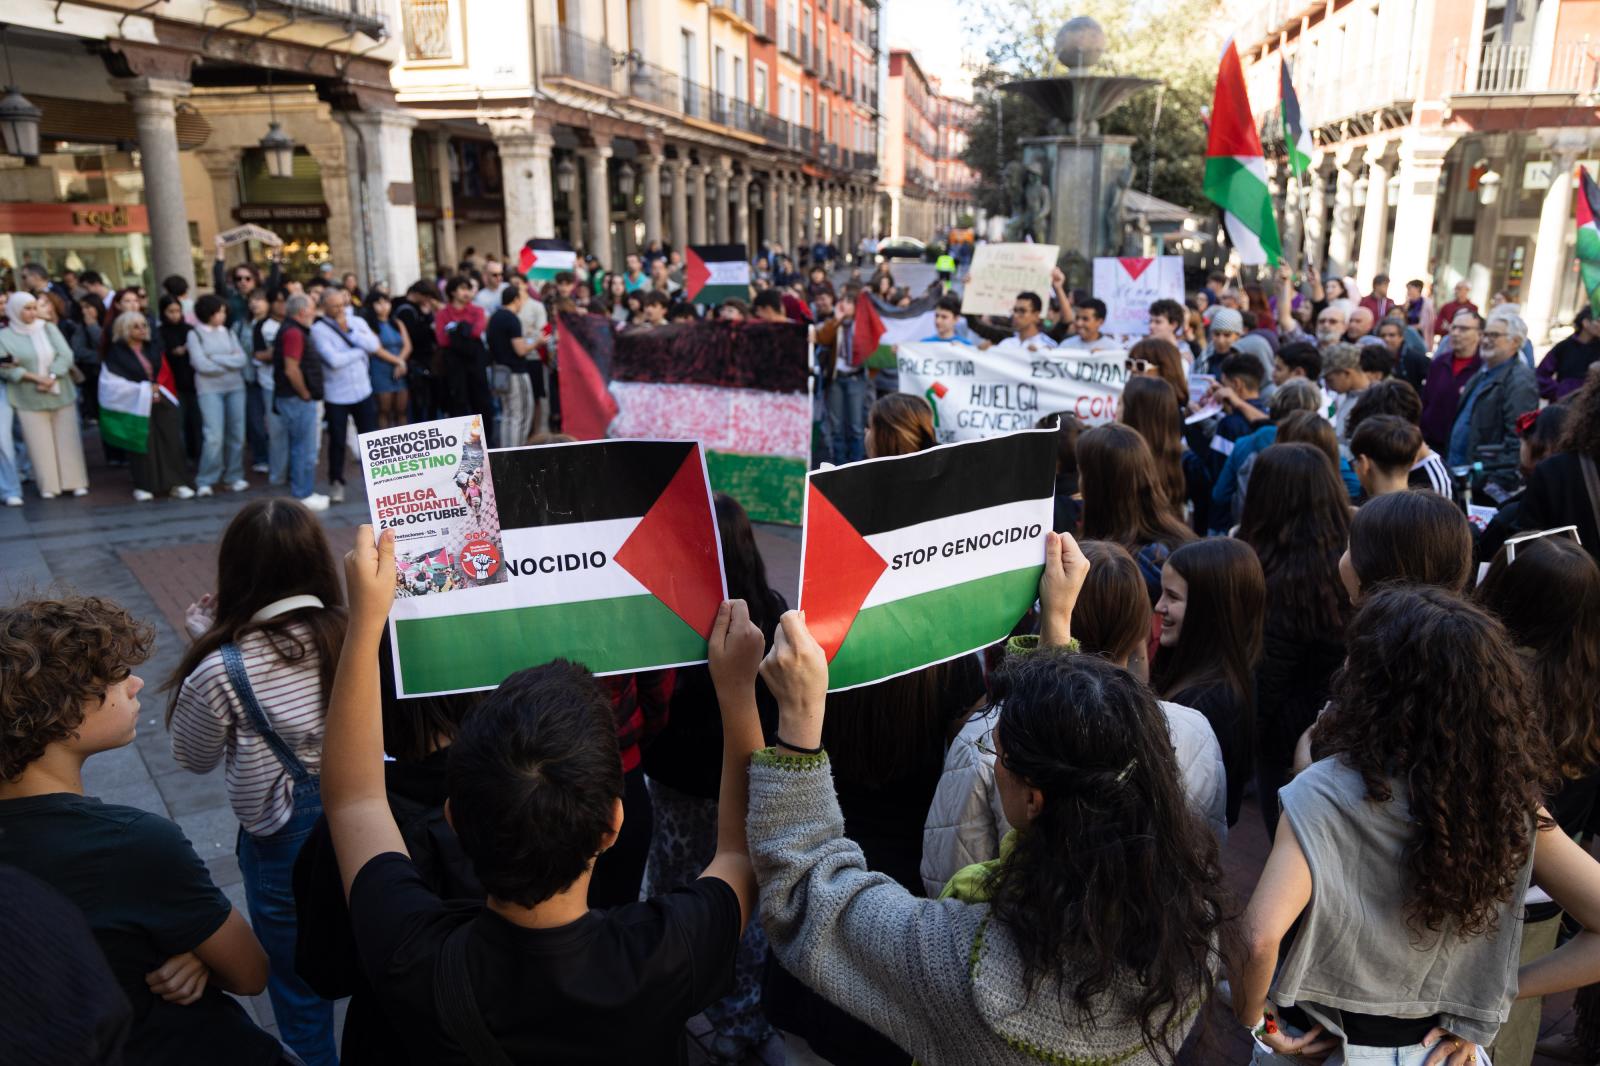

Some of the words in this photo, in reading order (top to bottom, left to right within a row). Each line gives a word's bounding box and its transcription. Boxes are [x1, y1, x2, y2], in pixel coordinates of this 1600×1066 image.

[899, 358, 975, 376] PALESTINA
[1031, 361, 1127, 384] ESTUDIAN
[970, 383, 1038, 411] HUELGA
[366, 430, 427, 449] PAREMOS
[428, 428, 442, 437] EL
[369, 435, 457, 460] GENOCIDIO
[370, 457, 397, 467] CONTRA
[405, 451, 430, 460] PUEBLO
[371, 454, 456, 479] PALESTINO
[376, 488, 437, 509] HUELGA
[378, 497, 460, 519] ESTUDIANTIL
[380, 520, 387, 529] 2
[389, 517, 405, 528] de
[406, 507, 468, 524] OCTUBRE
[891, 545, 937, 570] STOP
[941, 524, 1042, 558] GENOCIDIO
[505, 551, 607, 577] NOCIDIO
